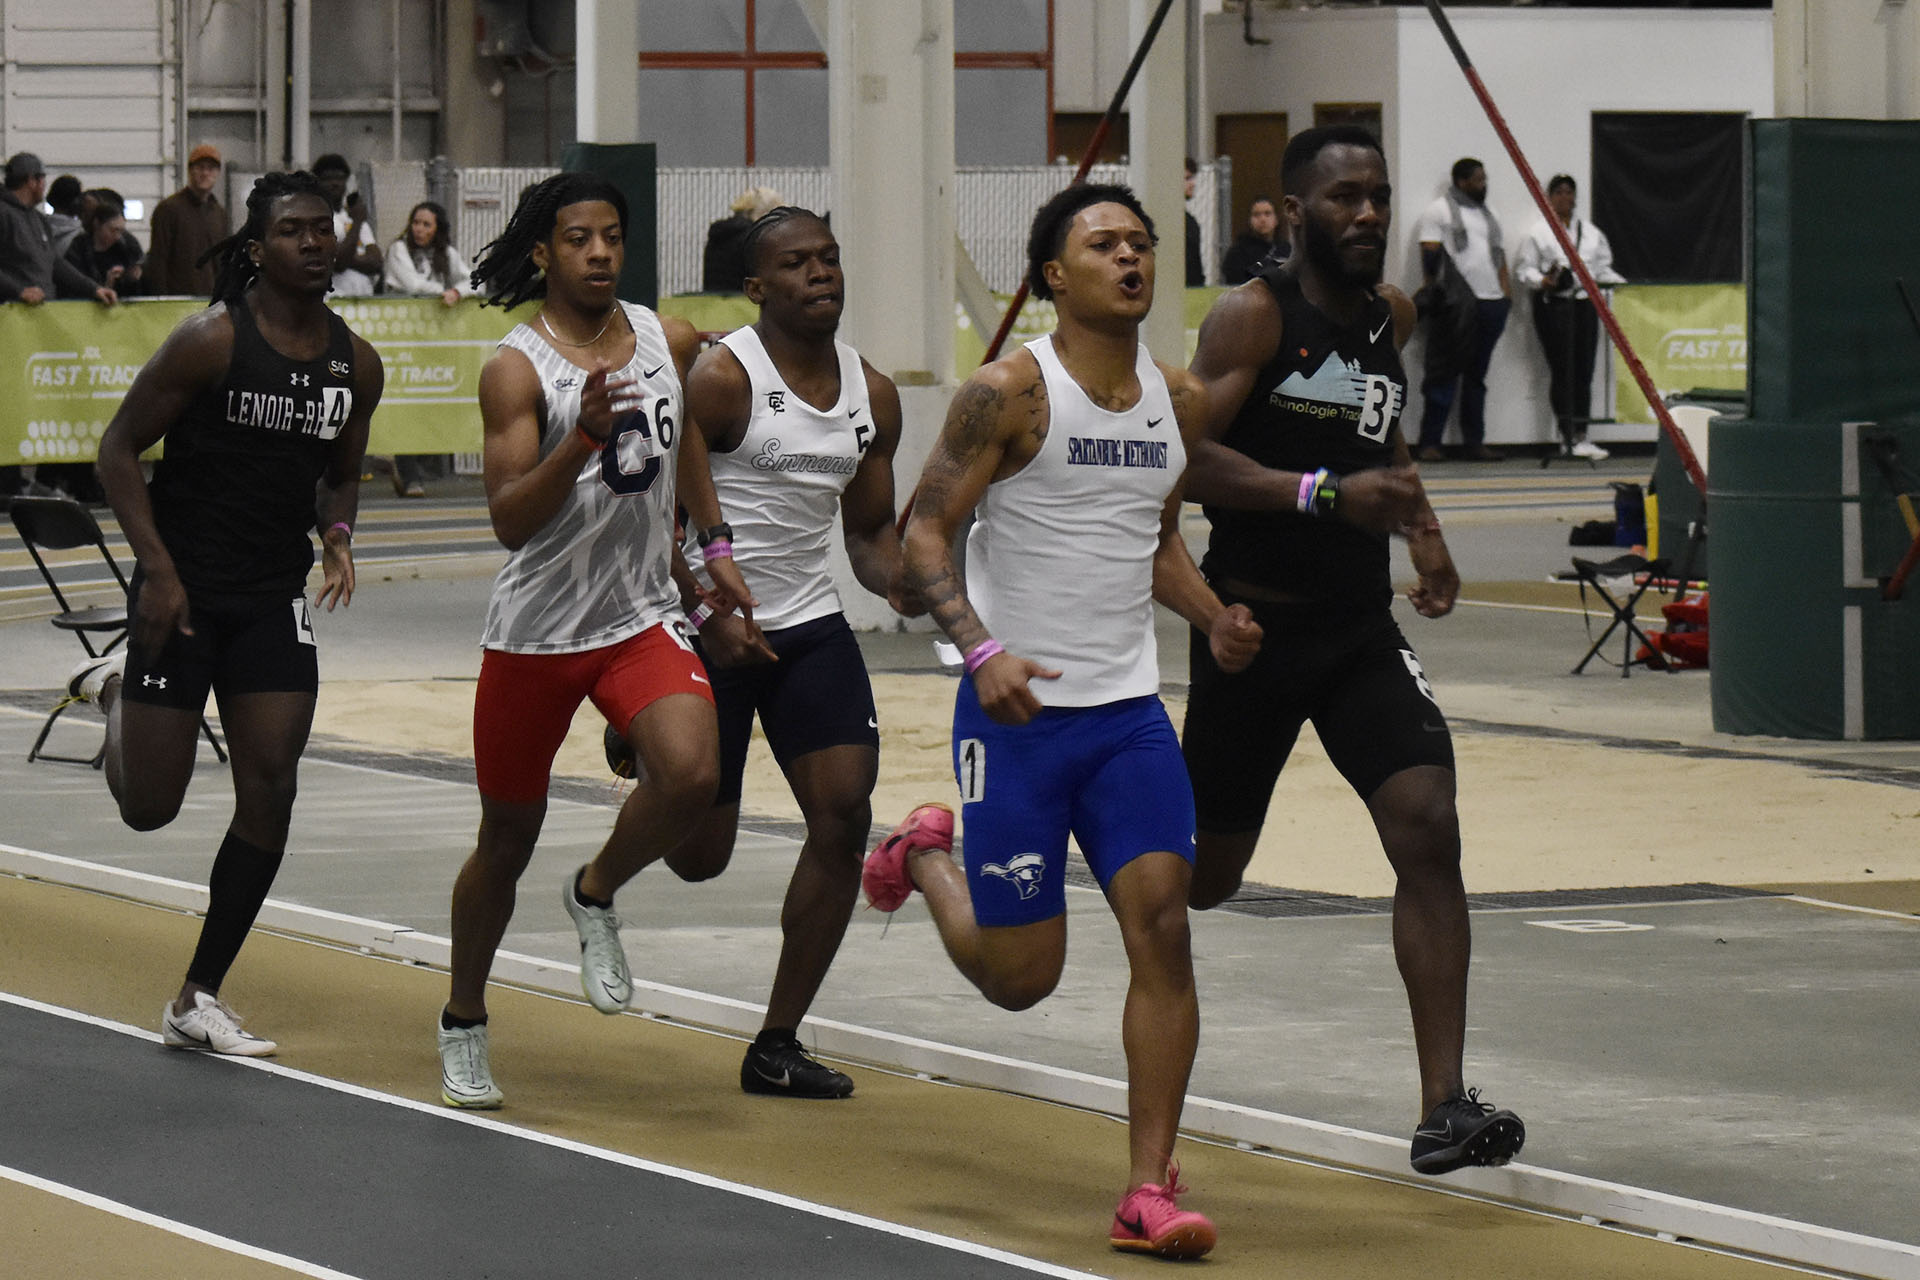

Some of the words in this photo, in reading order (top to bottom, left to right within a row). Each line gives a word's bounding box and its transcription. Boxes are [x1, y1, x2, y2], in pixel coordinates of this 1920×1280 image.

[330, 360, 349, 374] SAC
[1667, 340, 1721, 359] FAST
[32, 365, 82, 387] FAST
[401, 366, 456, 383] TRACK
[327, 390, 345, 436] 4
[655, 397, 674, 450] 6
[1269, 394, 1338, 419] Runologie
[1364, 380, 1388, 435] 3
[600, 407, 662, 497] C
[1067, 437, 1122, 466] SPARTANBURG
[1123, 440, 1168, 469] METHODIST
[300, 599, 315, 642] 4
[965, 742, 976, 798] 1
